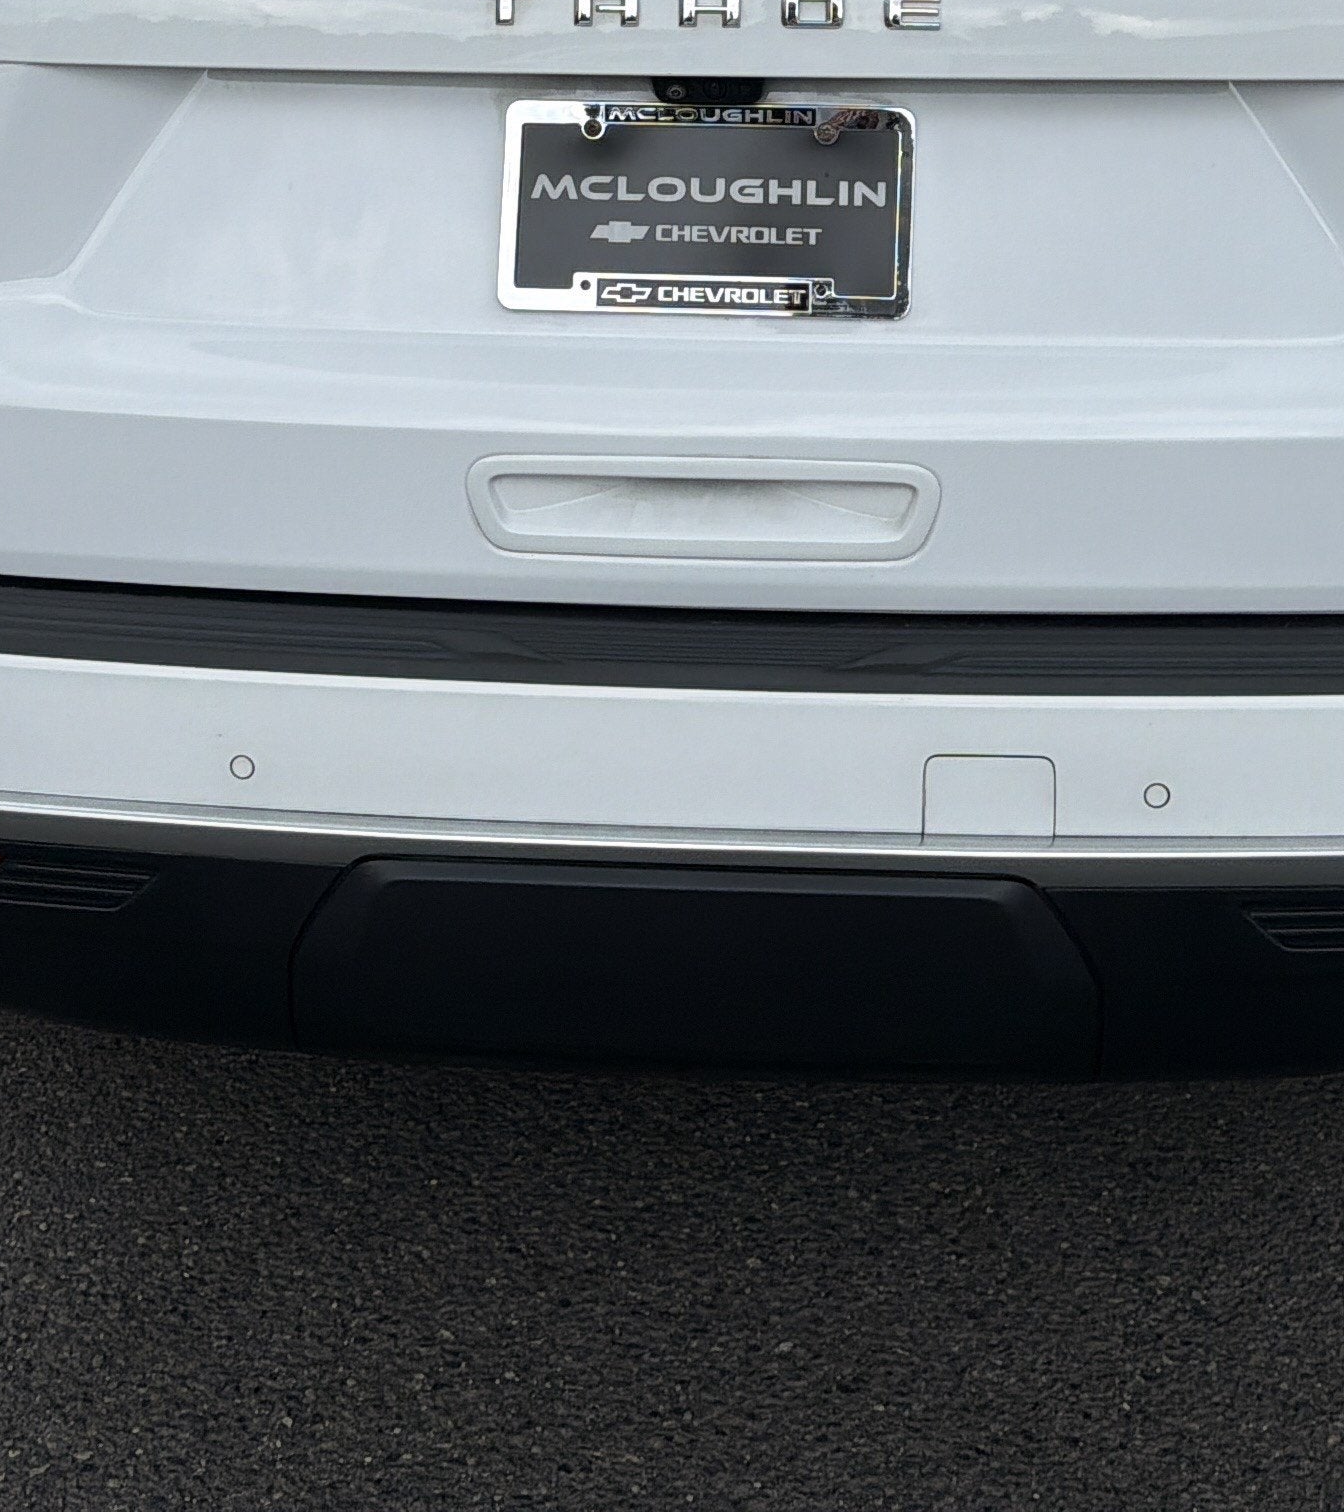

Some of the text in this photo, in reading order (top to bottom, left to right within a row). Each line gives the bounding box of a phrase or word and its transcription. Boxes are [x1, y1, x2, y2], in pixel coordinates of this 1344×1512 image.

[608, 106, 813, 125] MCLOUGHLIN
[530, 174, 887, 207] MCLOUGHLIN
[655, 223, 823, 246] CHEVROLET
[657, 285, 807, 305] CHEVROLET
